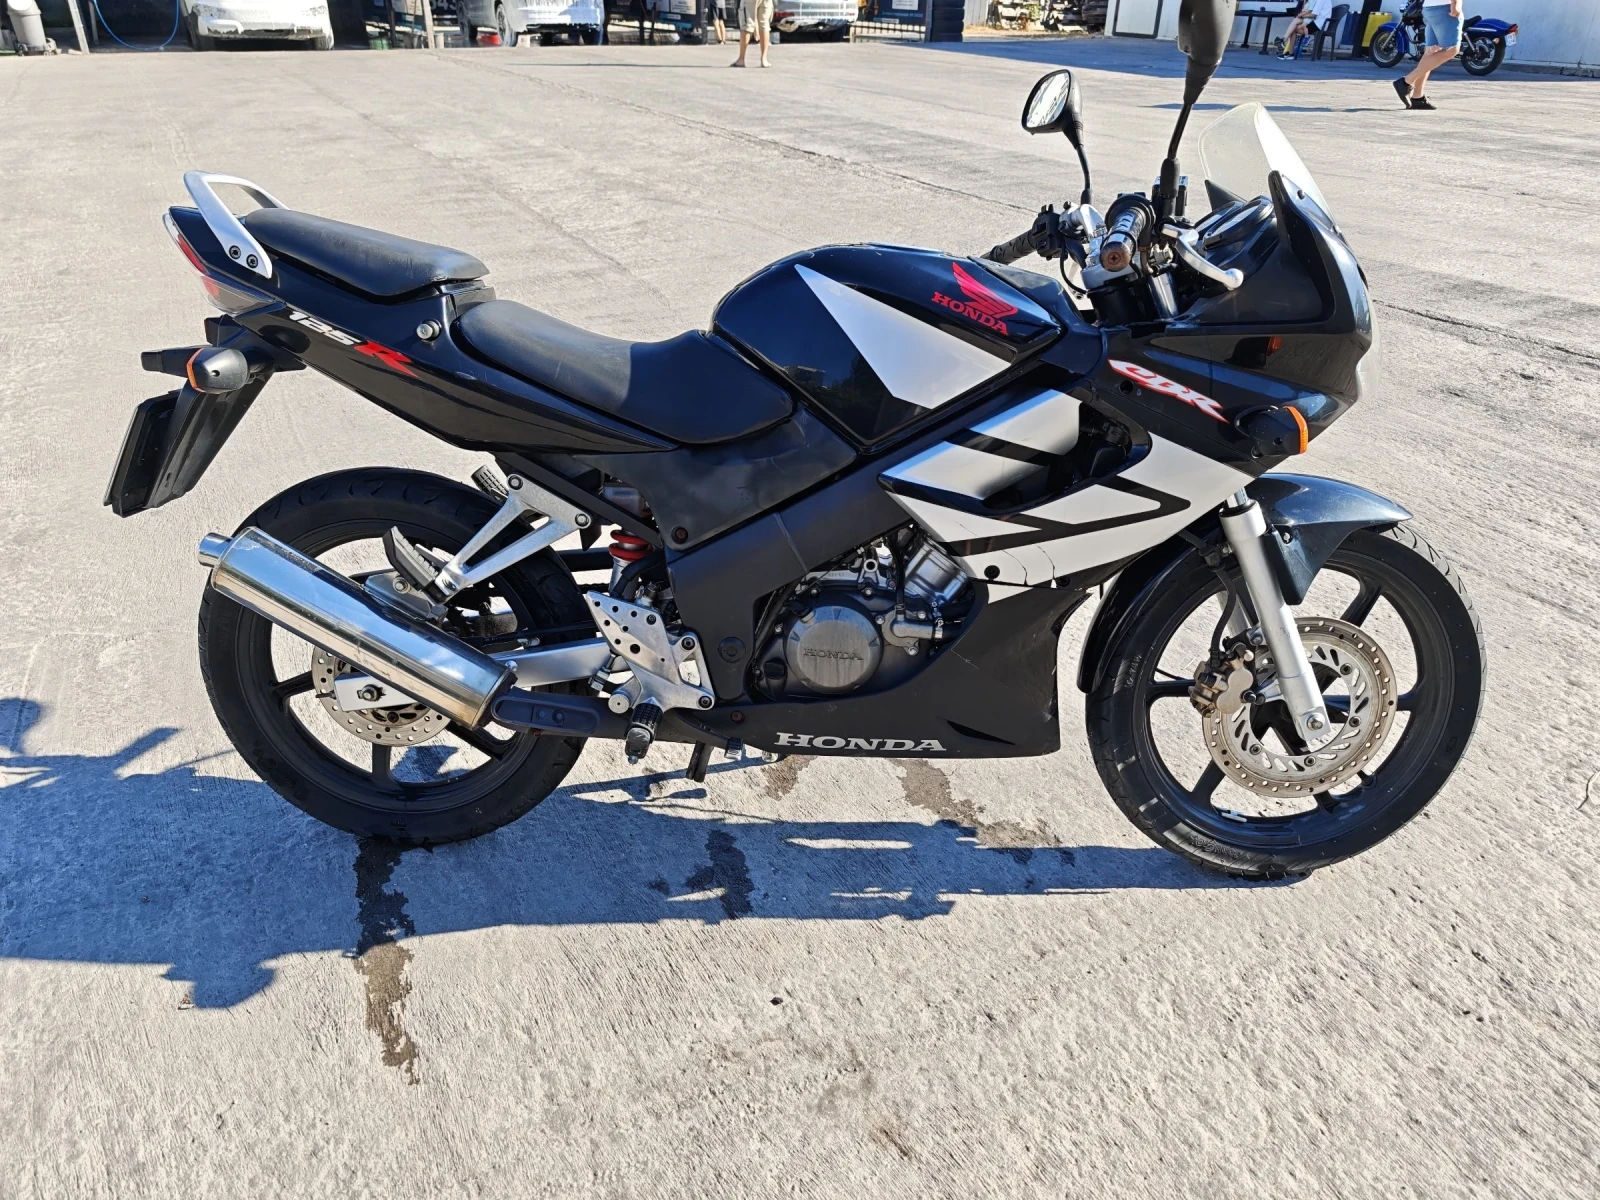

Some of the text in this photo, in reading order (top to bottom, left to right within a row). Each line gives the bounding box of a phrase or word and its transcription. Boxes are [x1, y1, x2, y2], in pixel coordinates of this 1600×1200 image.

[931, 291, 1009, 336] HONDA
[1108, 359, 1230, 424] CBR
[803, 647, 864, 661] HONDA
[774, 732, 947, 752] HONDA
